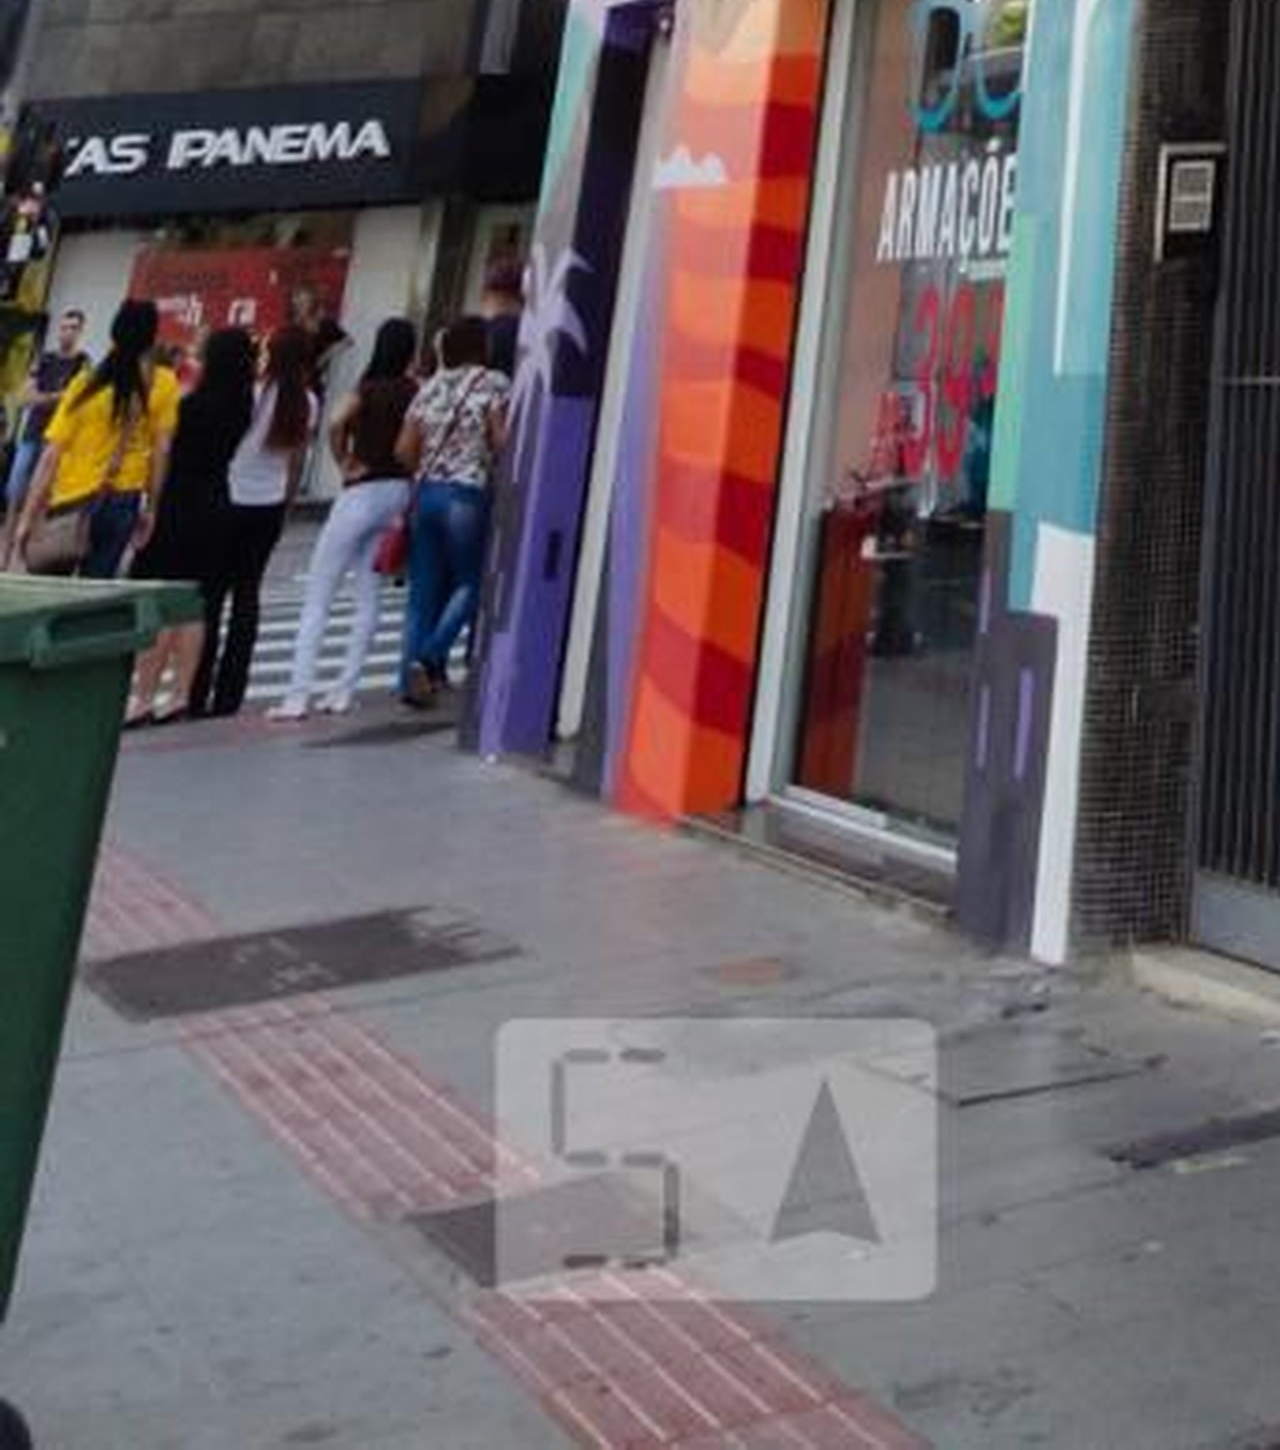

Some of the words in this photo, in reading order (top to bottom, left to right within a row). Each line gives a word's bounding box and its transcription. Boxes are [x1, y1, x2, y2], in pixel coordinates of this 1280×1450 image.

[65, 132, 148, 176] AS
[167, 118, 391, 170] IPANEMA
[876, 139, 1018, 264] ARMAÇÕE
